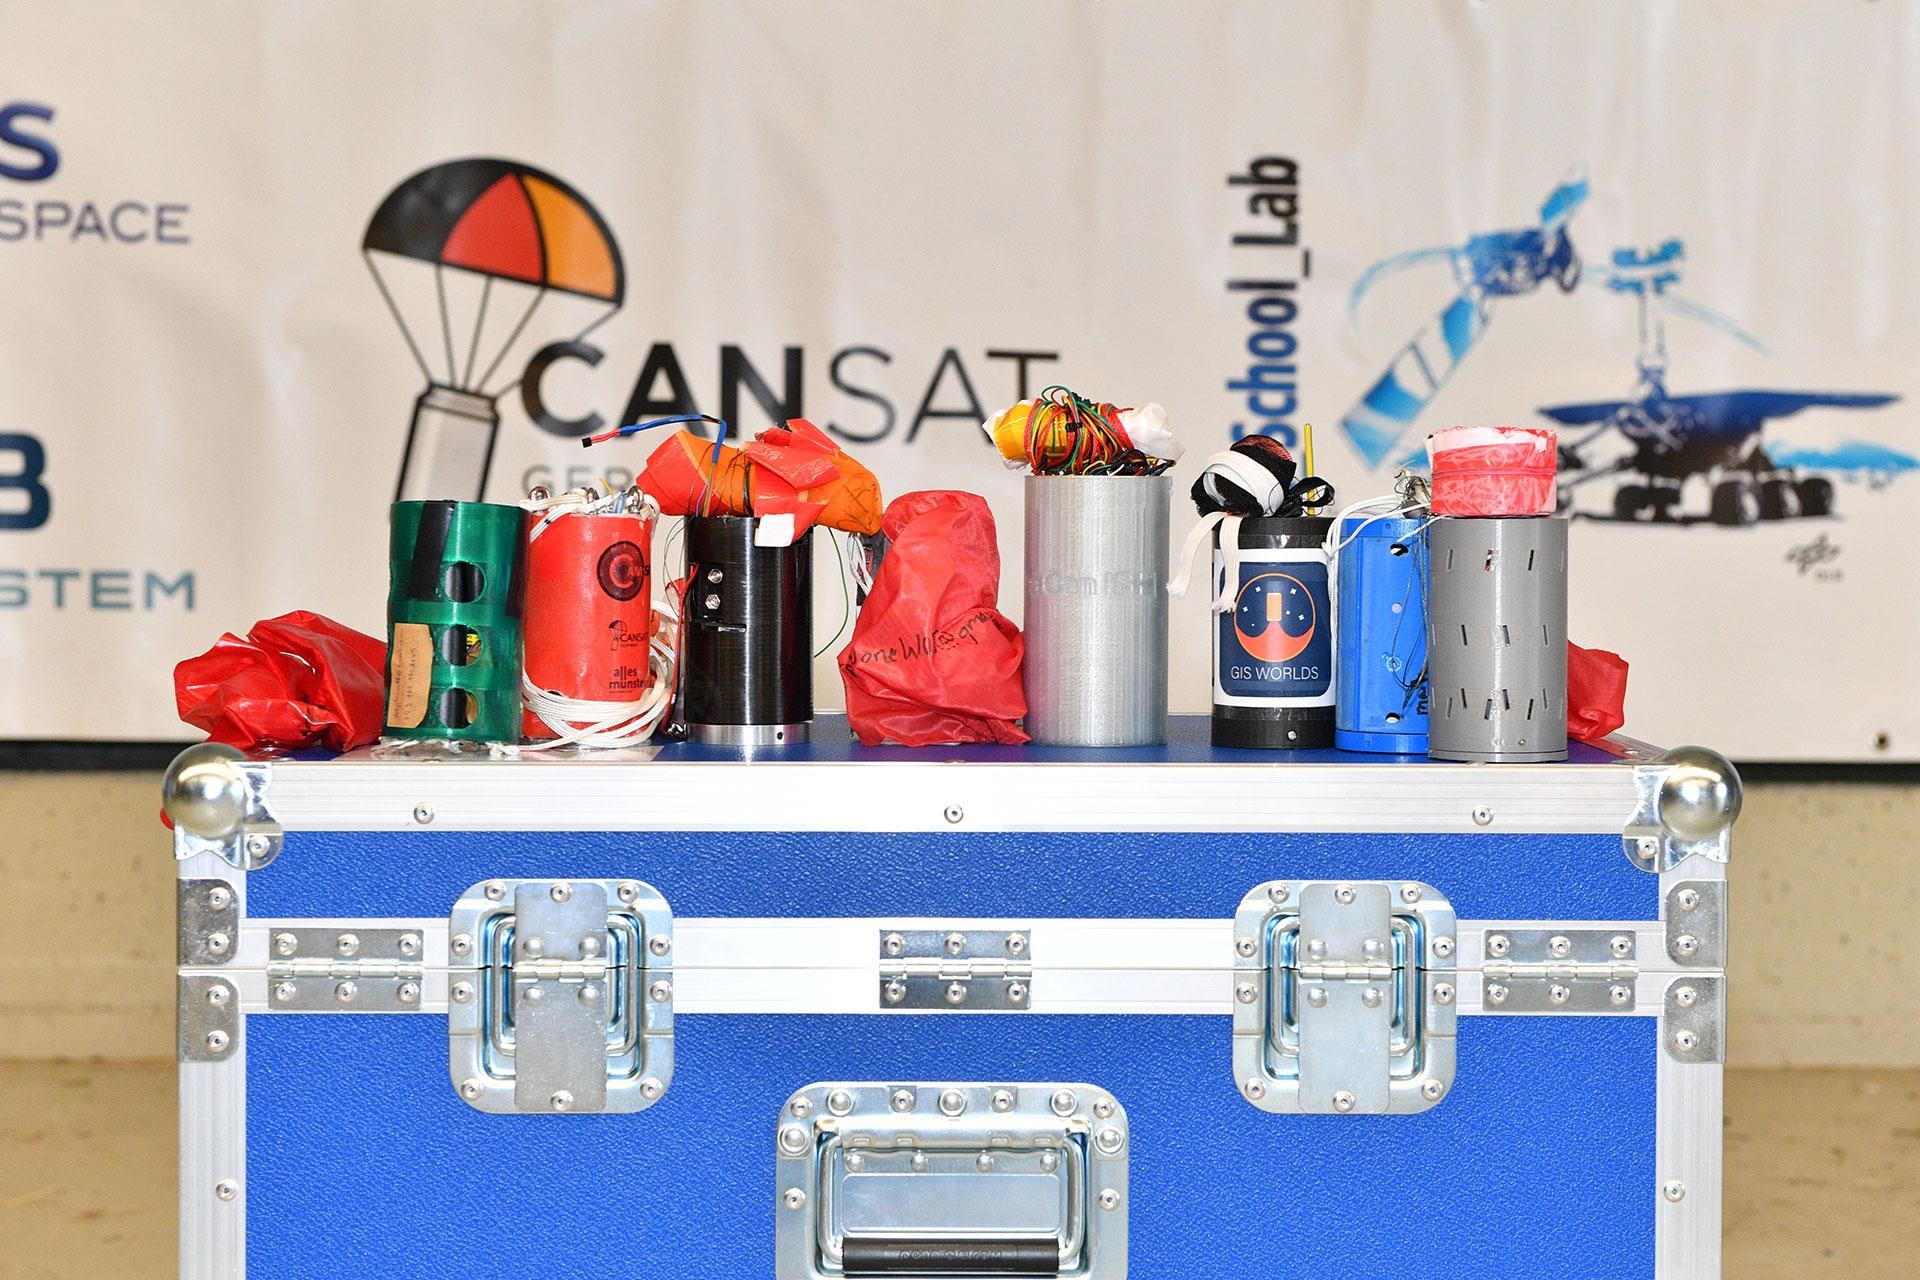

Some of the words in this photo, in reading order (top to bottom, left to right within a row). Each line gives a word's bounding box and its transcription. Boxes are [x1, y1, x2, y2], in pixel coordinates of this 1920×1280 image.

[520, 340, 1058, 444] CANSAT
[613, 665, 637, 681] alles
[1230, 666, 1252, 680] GIS
[1256, 666, 1319, 680] WORLDS
